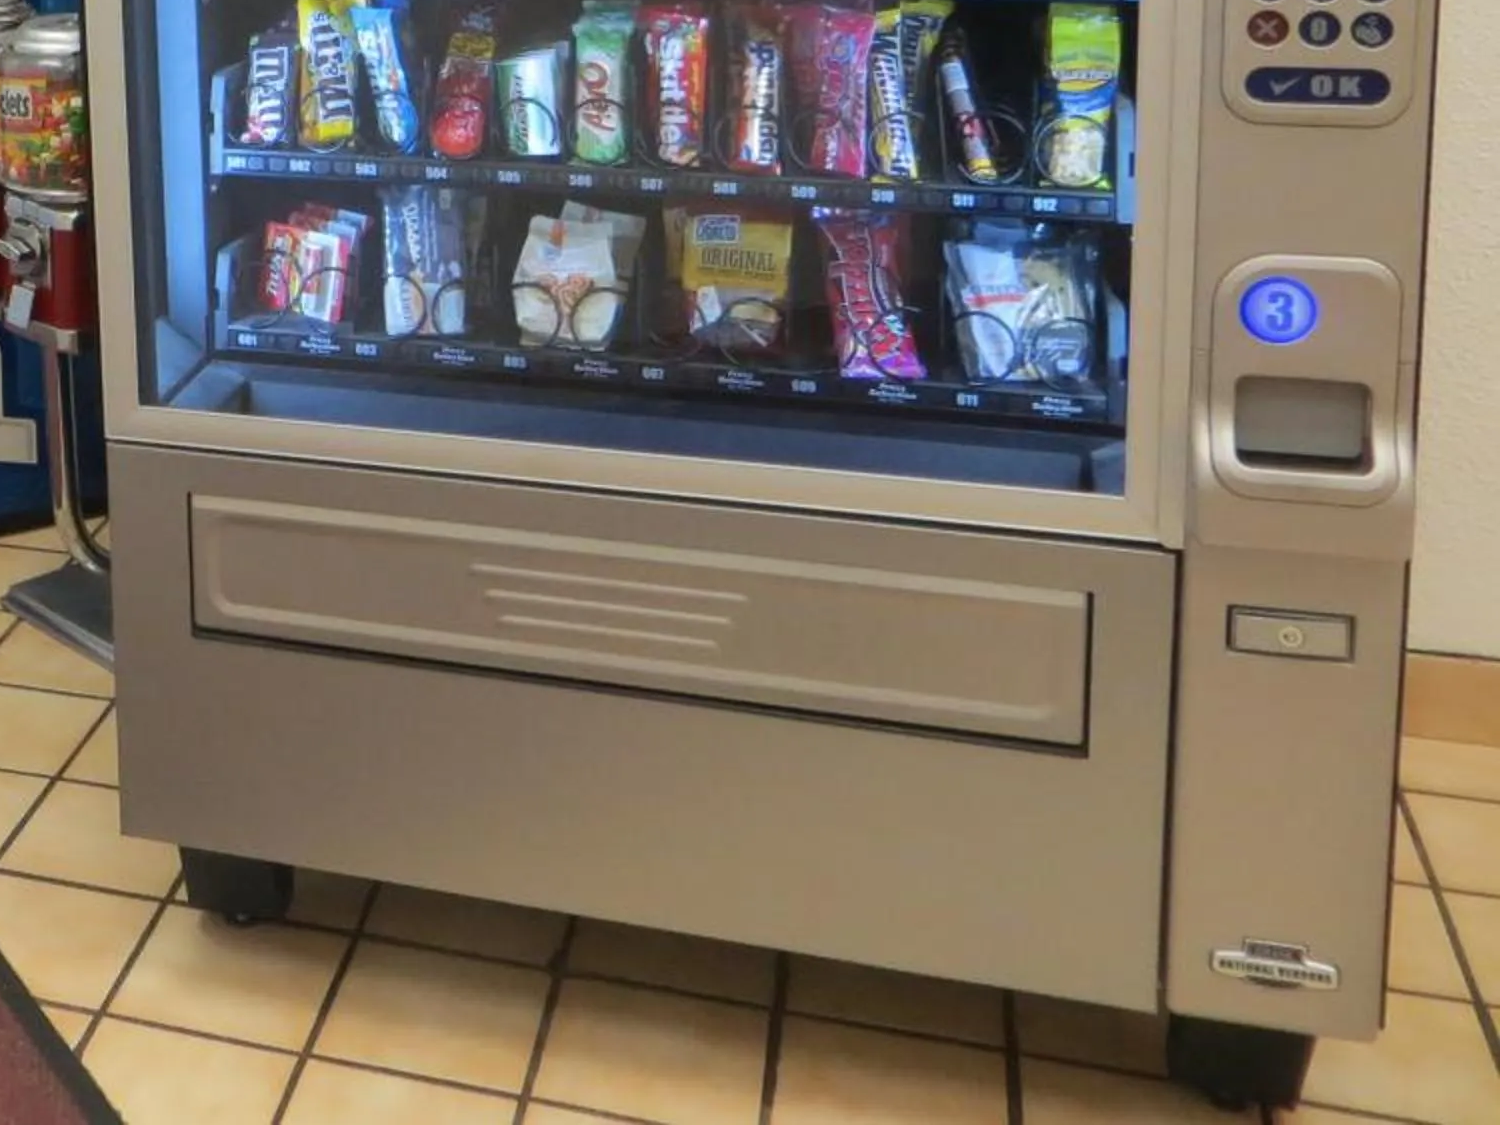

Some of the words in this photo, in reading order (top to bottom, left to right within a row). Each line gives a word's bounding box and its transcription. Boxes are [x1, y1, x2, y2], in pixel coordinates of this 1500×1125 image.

[1310, 18, 1327, 42] 0
[1310, 74, 1362, 99] OK
[425, 166, 448, 180] 504
[641, 178, 664, 192] 507
[700, 248, 776, 273] ORIGINAL
[1265, 290, 1295, 333] 3
